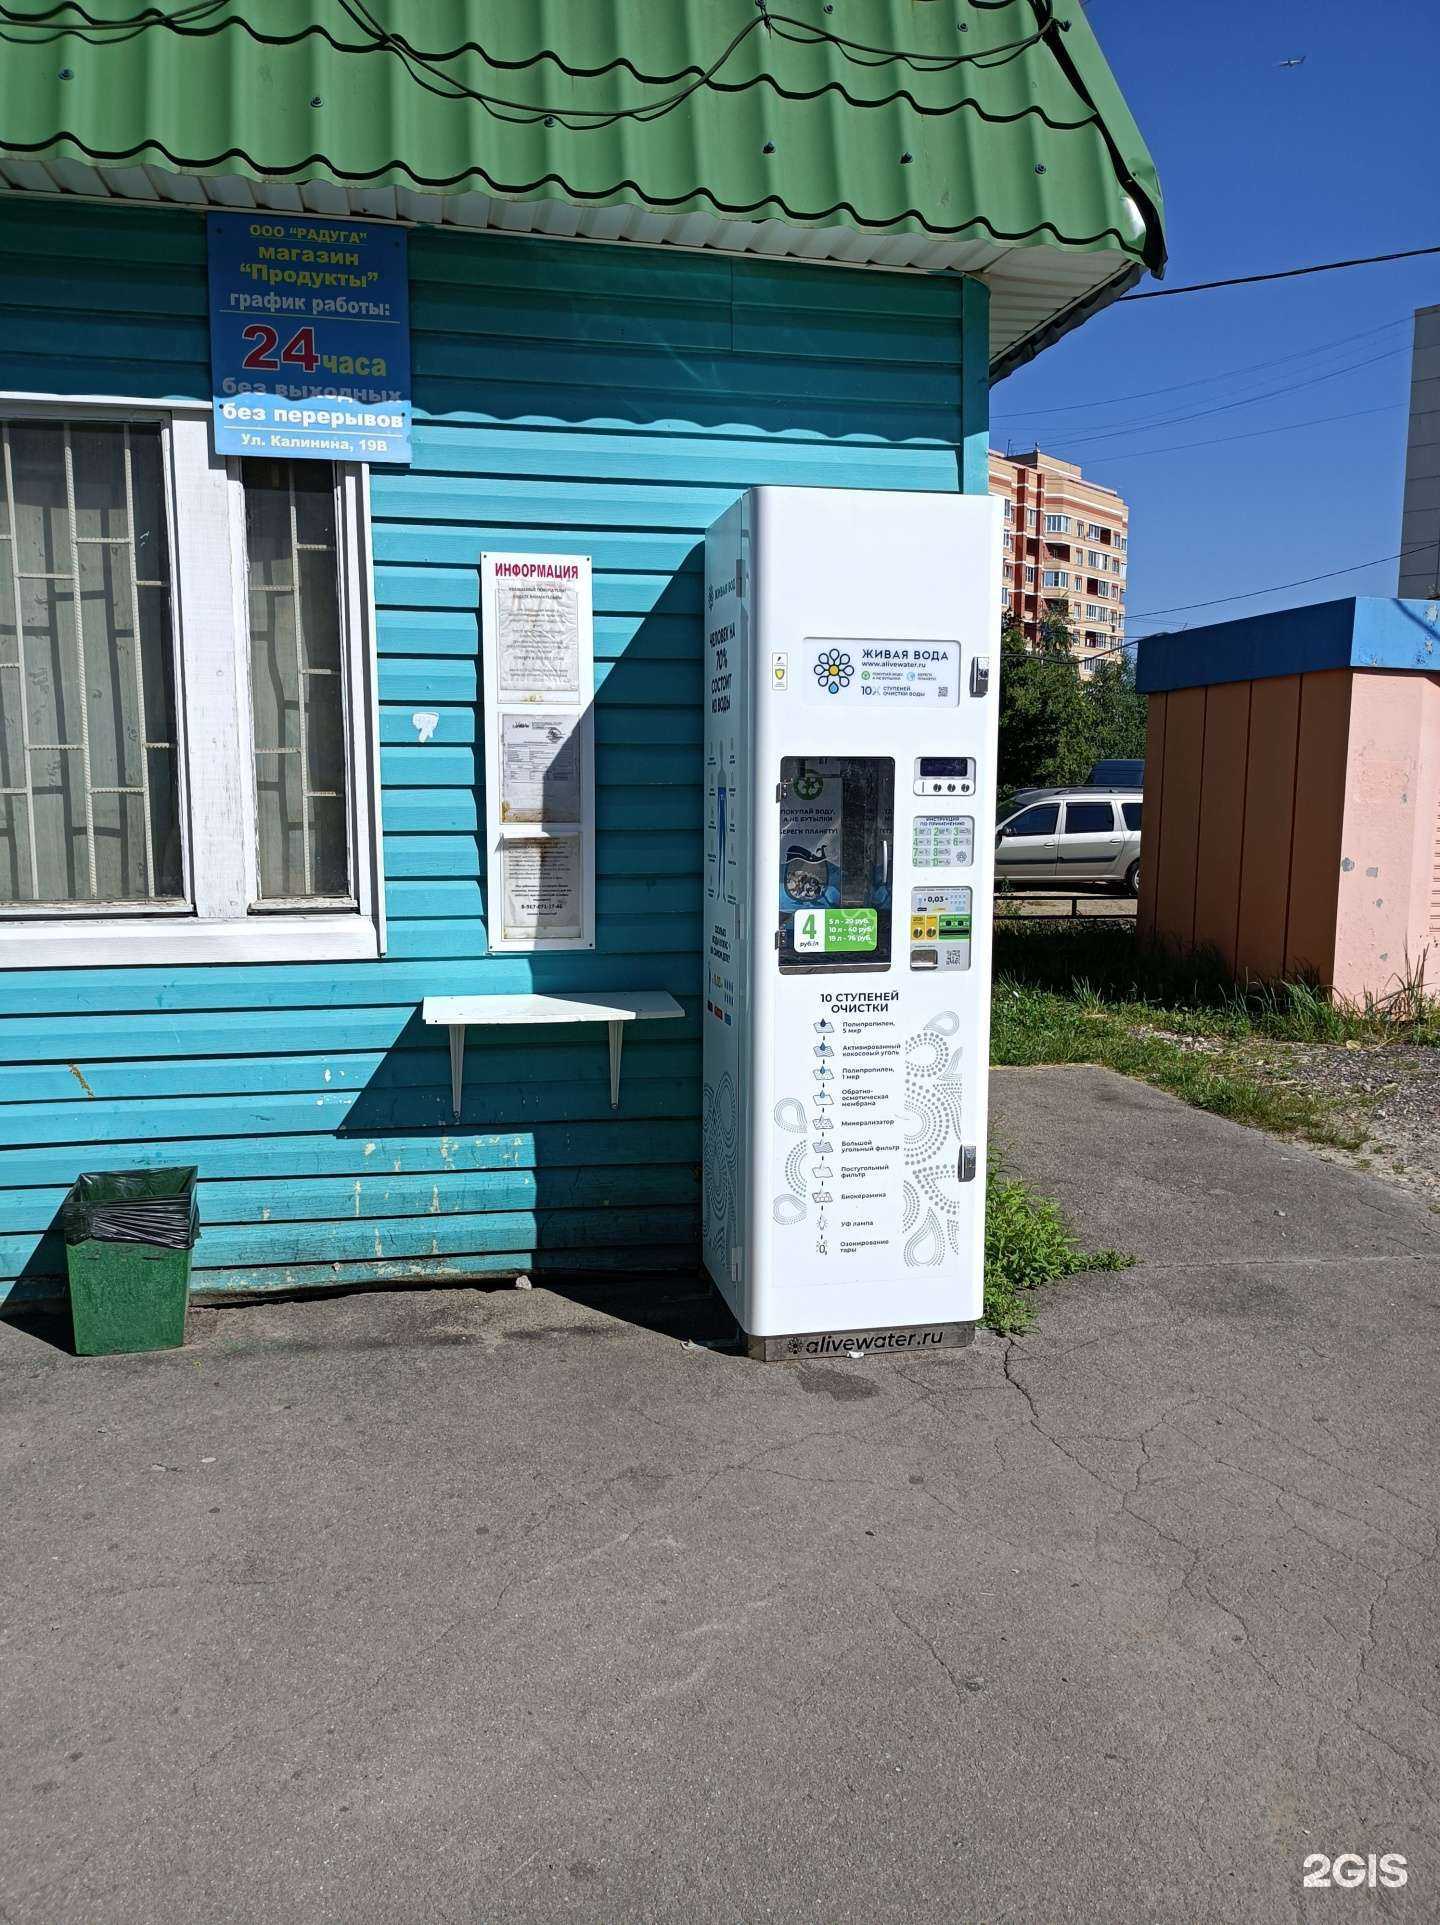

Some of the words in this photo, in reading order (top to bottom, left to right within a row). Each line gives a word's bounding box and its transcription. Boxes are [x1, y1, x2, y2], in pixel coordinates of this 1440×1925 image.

[250, 224, 285, 237] ООО
[258, 246, 359, 266] магазин
[230, 292, 305, 312] график
[312, 297, 390, 316] работы:
[242, 324, 320, 373] 24
[323, 354, 386, 377] часа
[222, 377, 267, 395] без
[275, 384, 402, 404] выходных
[223, 403, 266, 421] без
[274, 408, 403, 428] перерывов
[241, 433, 265, 447] Ул.
[271, 435, 354, 452] Калинина,
[495, 562, 579, 580] ИНФОРМАЦИЯ
[728, 578, 736, 593] ВОД
[862, 649, 909, 660] ЖИВАЯ
[913, 650, 949, 661] ВОДА
[862, 661, 926, 669] www.alivewater.ru
[712, 673, 732, 694] СОСТОИТ
[861, 686, 873, 696] 10
[802, 914, 817, 940] 4
[820, 993, 832, 1003] 10
[836, 990, 899, 1002] СТУПЕНЕЙ
[831, 1003, 889, 1014] ОЧИСТКИ
[841, 1119, 894, 1127] Минерализатор
[841, 1192, 887, 1200] Биокерамика
[806, 1330, 944, 1354] alivewater.ru
